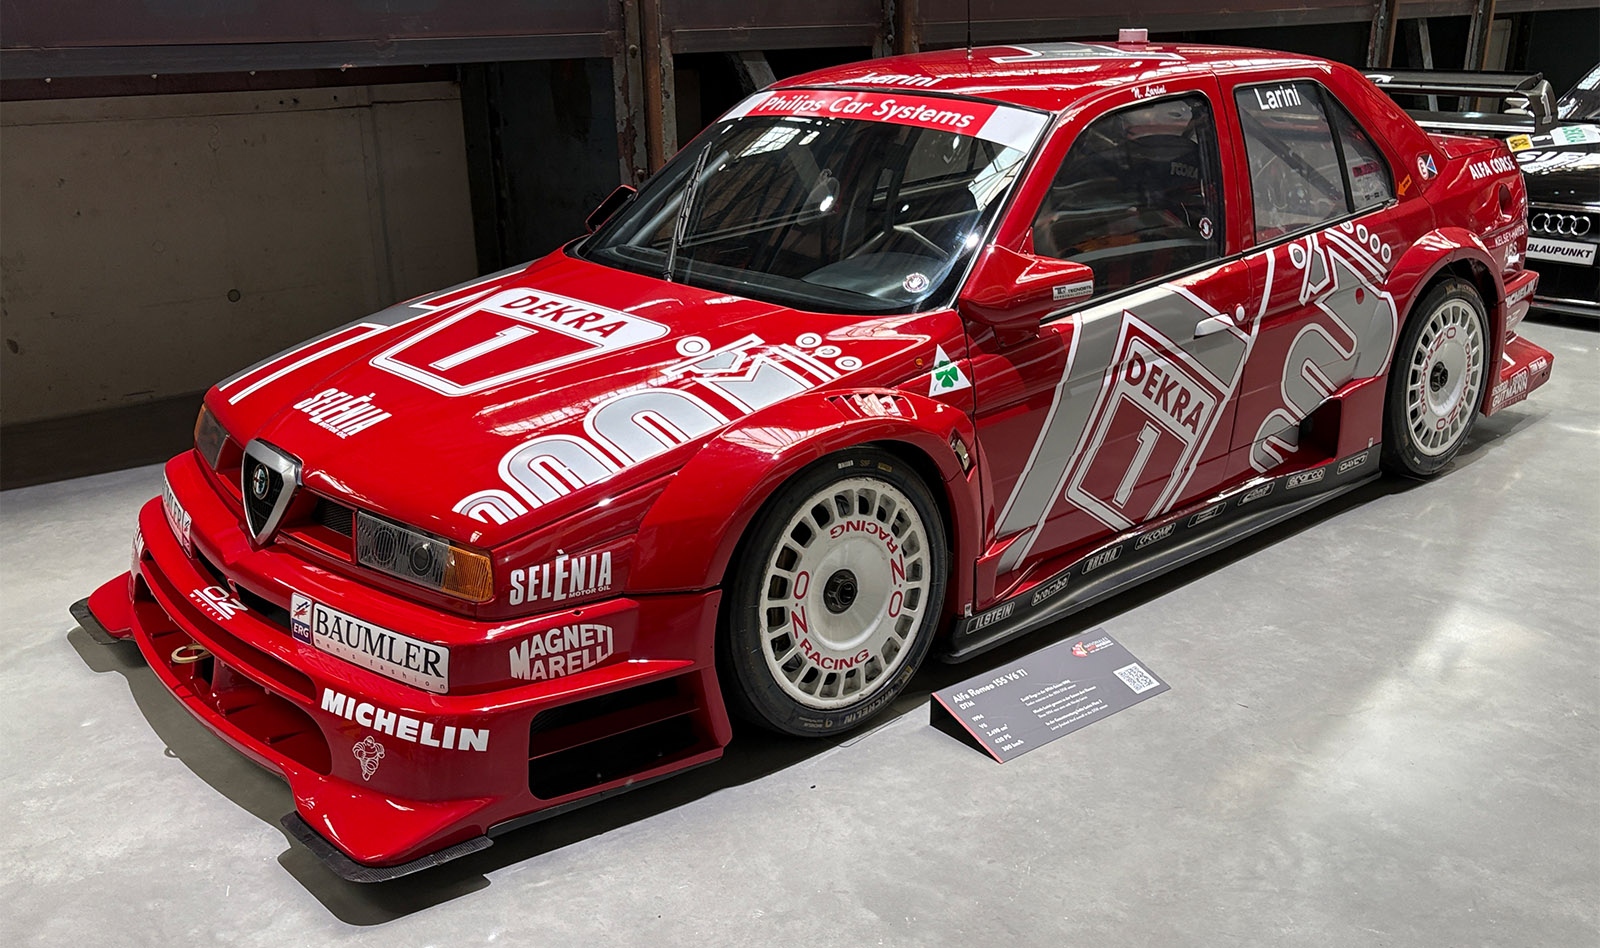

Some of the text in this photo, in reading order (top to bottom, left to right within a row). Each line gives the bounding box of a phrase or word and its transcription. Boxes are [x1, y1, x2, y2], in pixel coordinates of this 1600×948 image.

[760, 94, 975, 128] Philips Car Systems
[1254, 84, 1301, 110] Larini
[1469, 160, 1493, 180] ALFA
[1491, 155, 1516, 174] CORSE
[1527, 243, 1593, 258] BLAUPUNKT
[499, 296, 629, 339] DEKRA
[429, 325, 539, 371] 1
[1124, 351, 1204, 435] DEKRA
[1112, 421, 1161, 509] 1
[829, 521, 898, 554] RACING
[509, 549, 612, 606] SELÈNIA
[568, 587, 596, 599] MOTOR
[293, 624, 310, 638] ERG
[509, 624, 614, 660] MAGNETI
[509, 643, 614, 680] MARELLI
[799, 638, 870, 670] RACING
[370, 660, 446, 689] fashion
[953, 693, 970, 704] Alfa
[970, 683, 995, 697] Romeo
[993, 676, 1008, 689] 155
[1005, 671, 1019, 682] V6
[320, 688, 490, 752] MICHELIN
[959, 700, 975, 710] DTM
